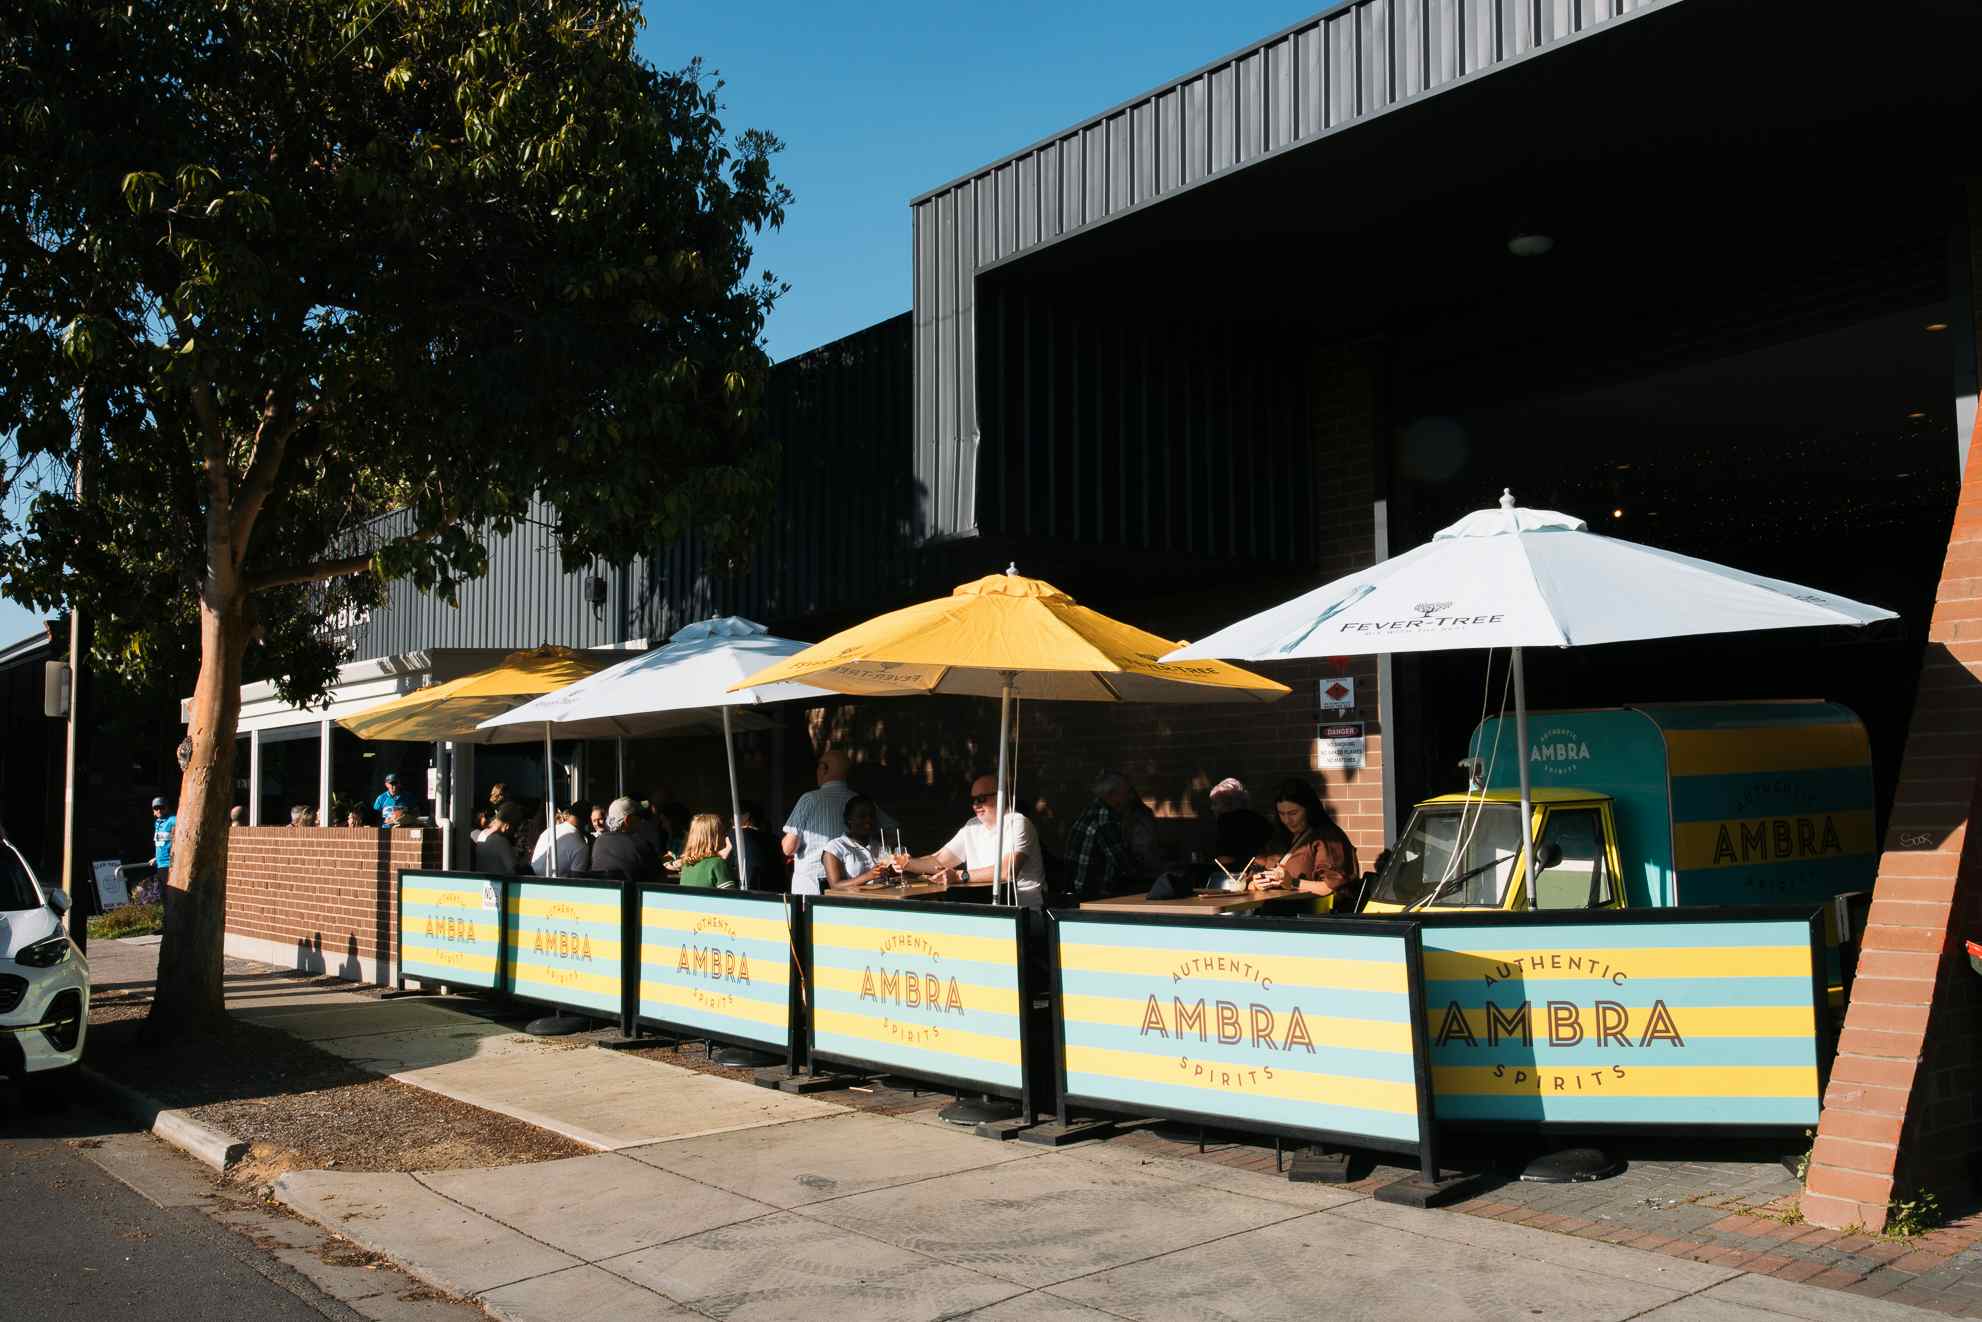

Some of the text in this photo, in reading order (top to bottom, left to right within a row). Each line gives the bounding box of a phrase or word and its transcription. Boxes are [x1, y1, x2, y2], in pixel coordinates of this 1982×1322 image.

[1340, 614, 1505, 632] FEVER-TREE
[1327, 727, 1355, 736] DANGER
[1529, 741, 1591, 762] AMBRA
[1713, 815, 1843, 865] AMBRA
[425, 914, 477, 943] AMBRA
[533, 927, 593, 961] AMBRA
[692, 916, 737, 941] AUTHENTIC
[676, 943, 751, 985] AMBRA
[879, 934, 942, 963] AUTHENTIC
[1171, 956, 1274, 991] AUTHENTIC
[1483, 954, 1628, 988] AUTHENTIC
[859, 965, 965, 1016] AMBRA
[882, 1016, 940, 1043] SPIRITS
[1138, 993, 1317, 1055] AMBRA
[1434, 999, 1686, 1048] AMBRA
[1179, 1055, 1274, 1088] SPIRITS
[1493, 1063, 1627, 1091] SPIRITS
